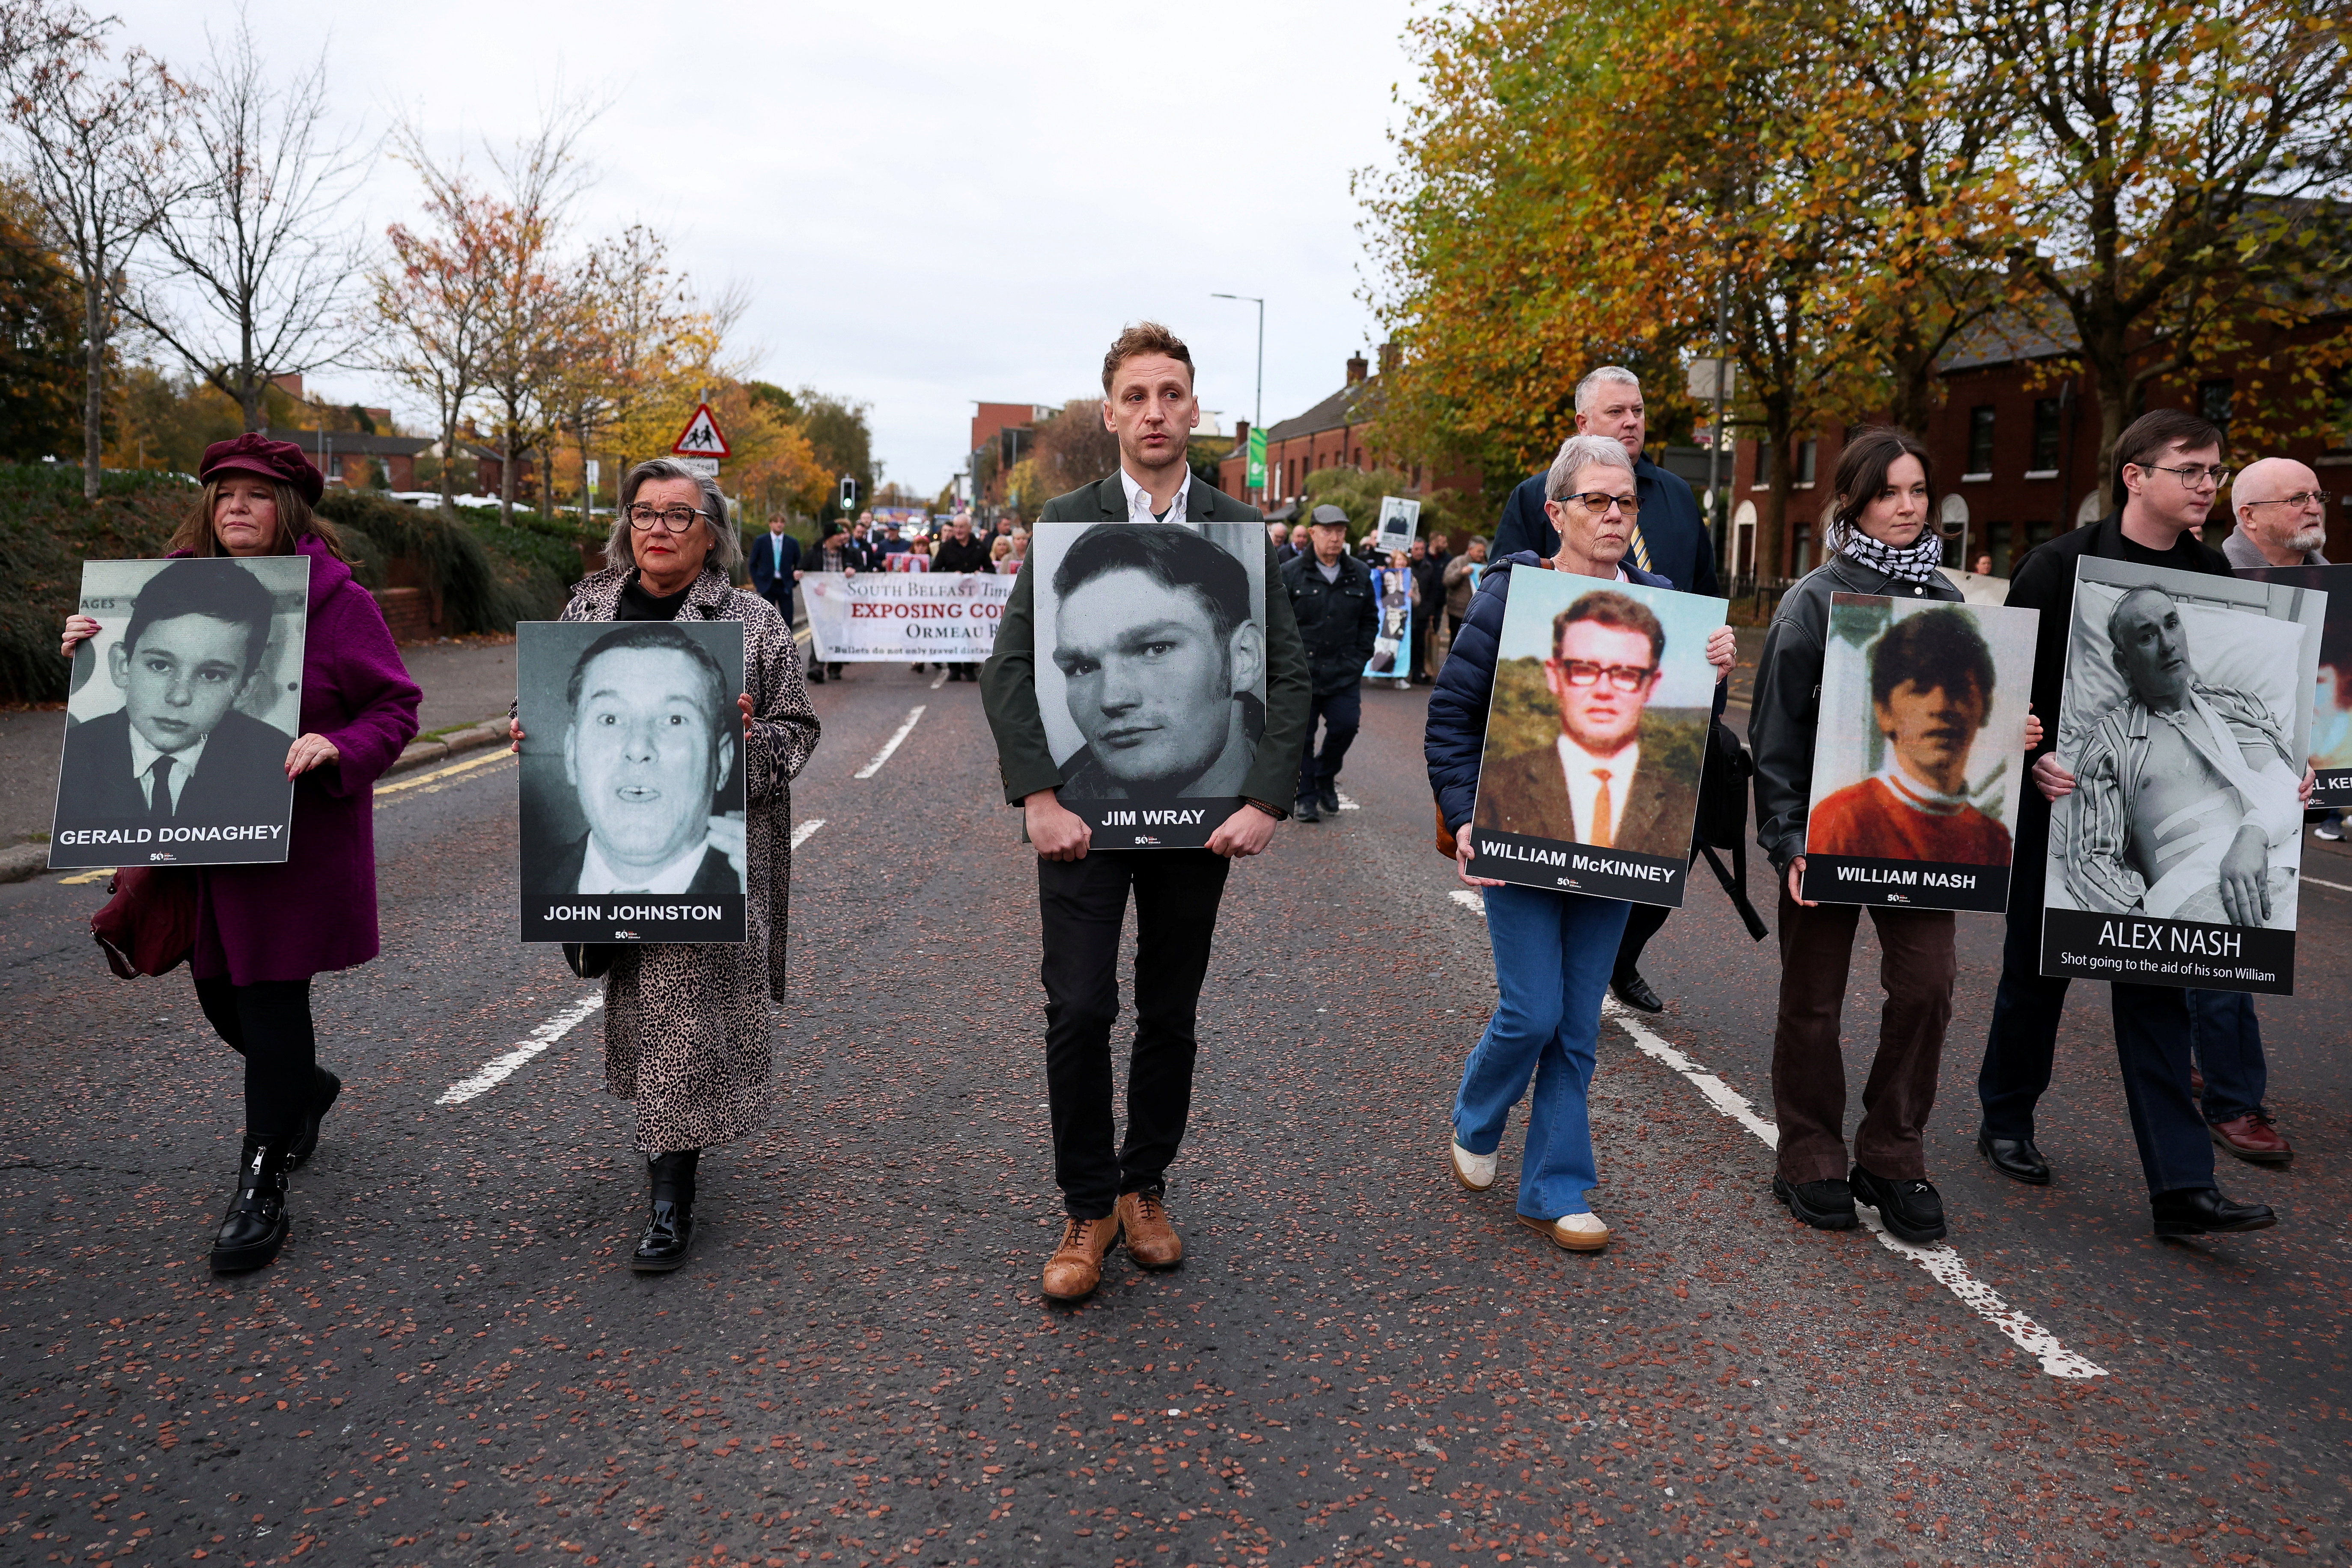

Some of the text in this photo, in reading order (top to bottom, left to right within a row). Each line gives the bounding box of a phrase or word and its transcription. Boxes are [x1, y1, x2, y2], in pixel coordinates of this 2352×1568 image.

[847, 581, 902, 597] SOUTH
[908, 582, 974, 597] BELFAST
[80, 598, 115, 609] AGES
[851, 603, 962, 618] EXPOSING
[906, 623, 983, 639] ORMEAU
[929, 646, 958, 655] travel
[2312, 777, 2352, 790] L KE
[1102, 809, 1206, 826] JIM WRAY
[60, 825, 283, 845] GERALD DONAGHEY
[1481, 840, 1676, 884] WILLIAM McKINNEY
[1557, 878, 1569, 886] 50
[1837, 866, 1976, 889] WILLIAM NASH
[544, 906, 721, 921] JOHN JOHNSTON
[2098, 921, 2241, 957] ALEX NASH
[2061, 952, 2275, 982] Shot going to the aid of his son William
